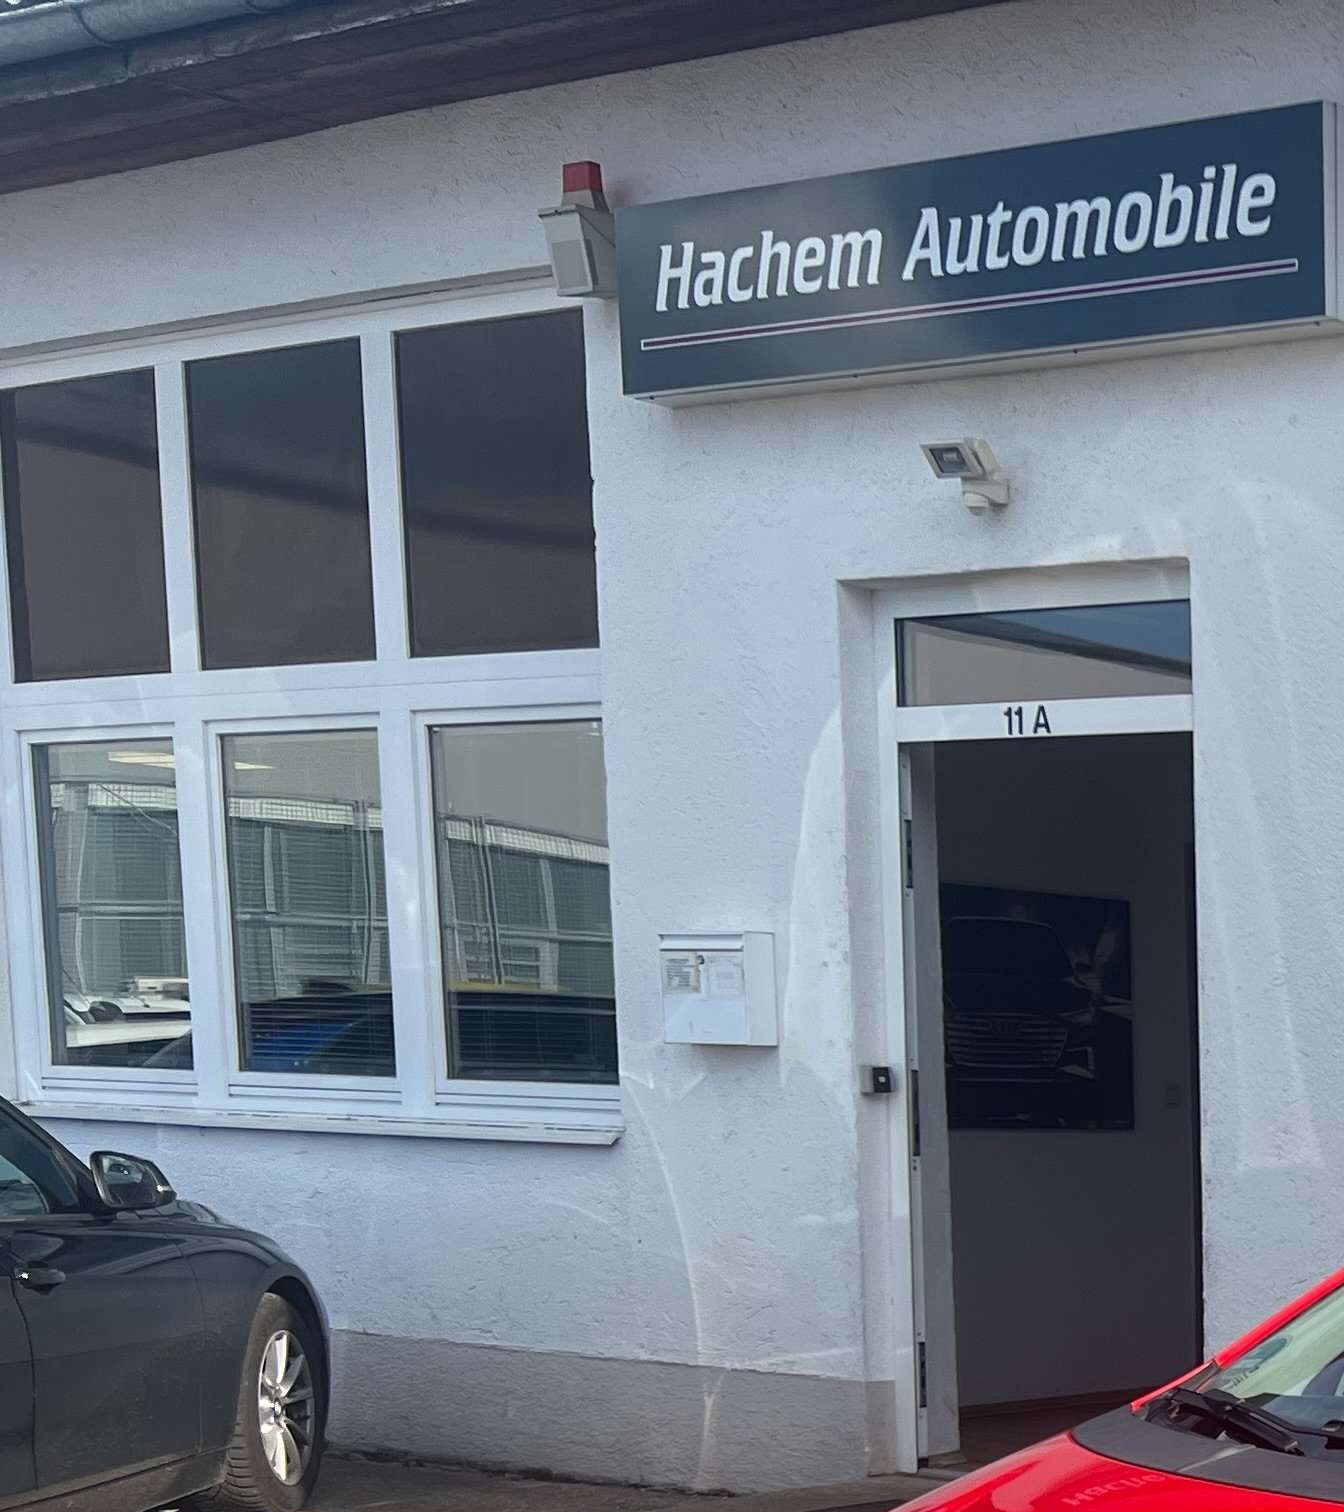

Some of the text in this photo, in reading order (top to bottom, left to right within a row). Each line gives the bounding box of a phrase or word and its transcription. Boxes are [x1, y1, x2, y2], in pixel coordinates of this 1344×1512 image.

[654, 162, 1278, 313] Hachem Automobile
[1003, 704, 1052, 736] 11 A
